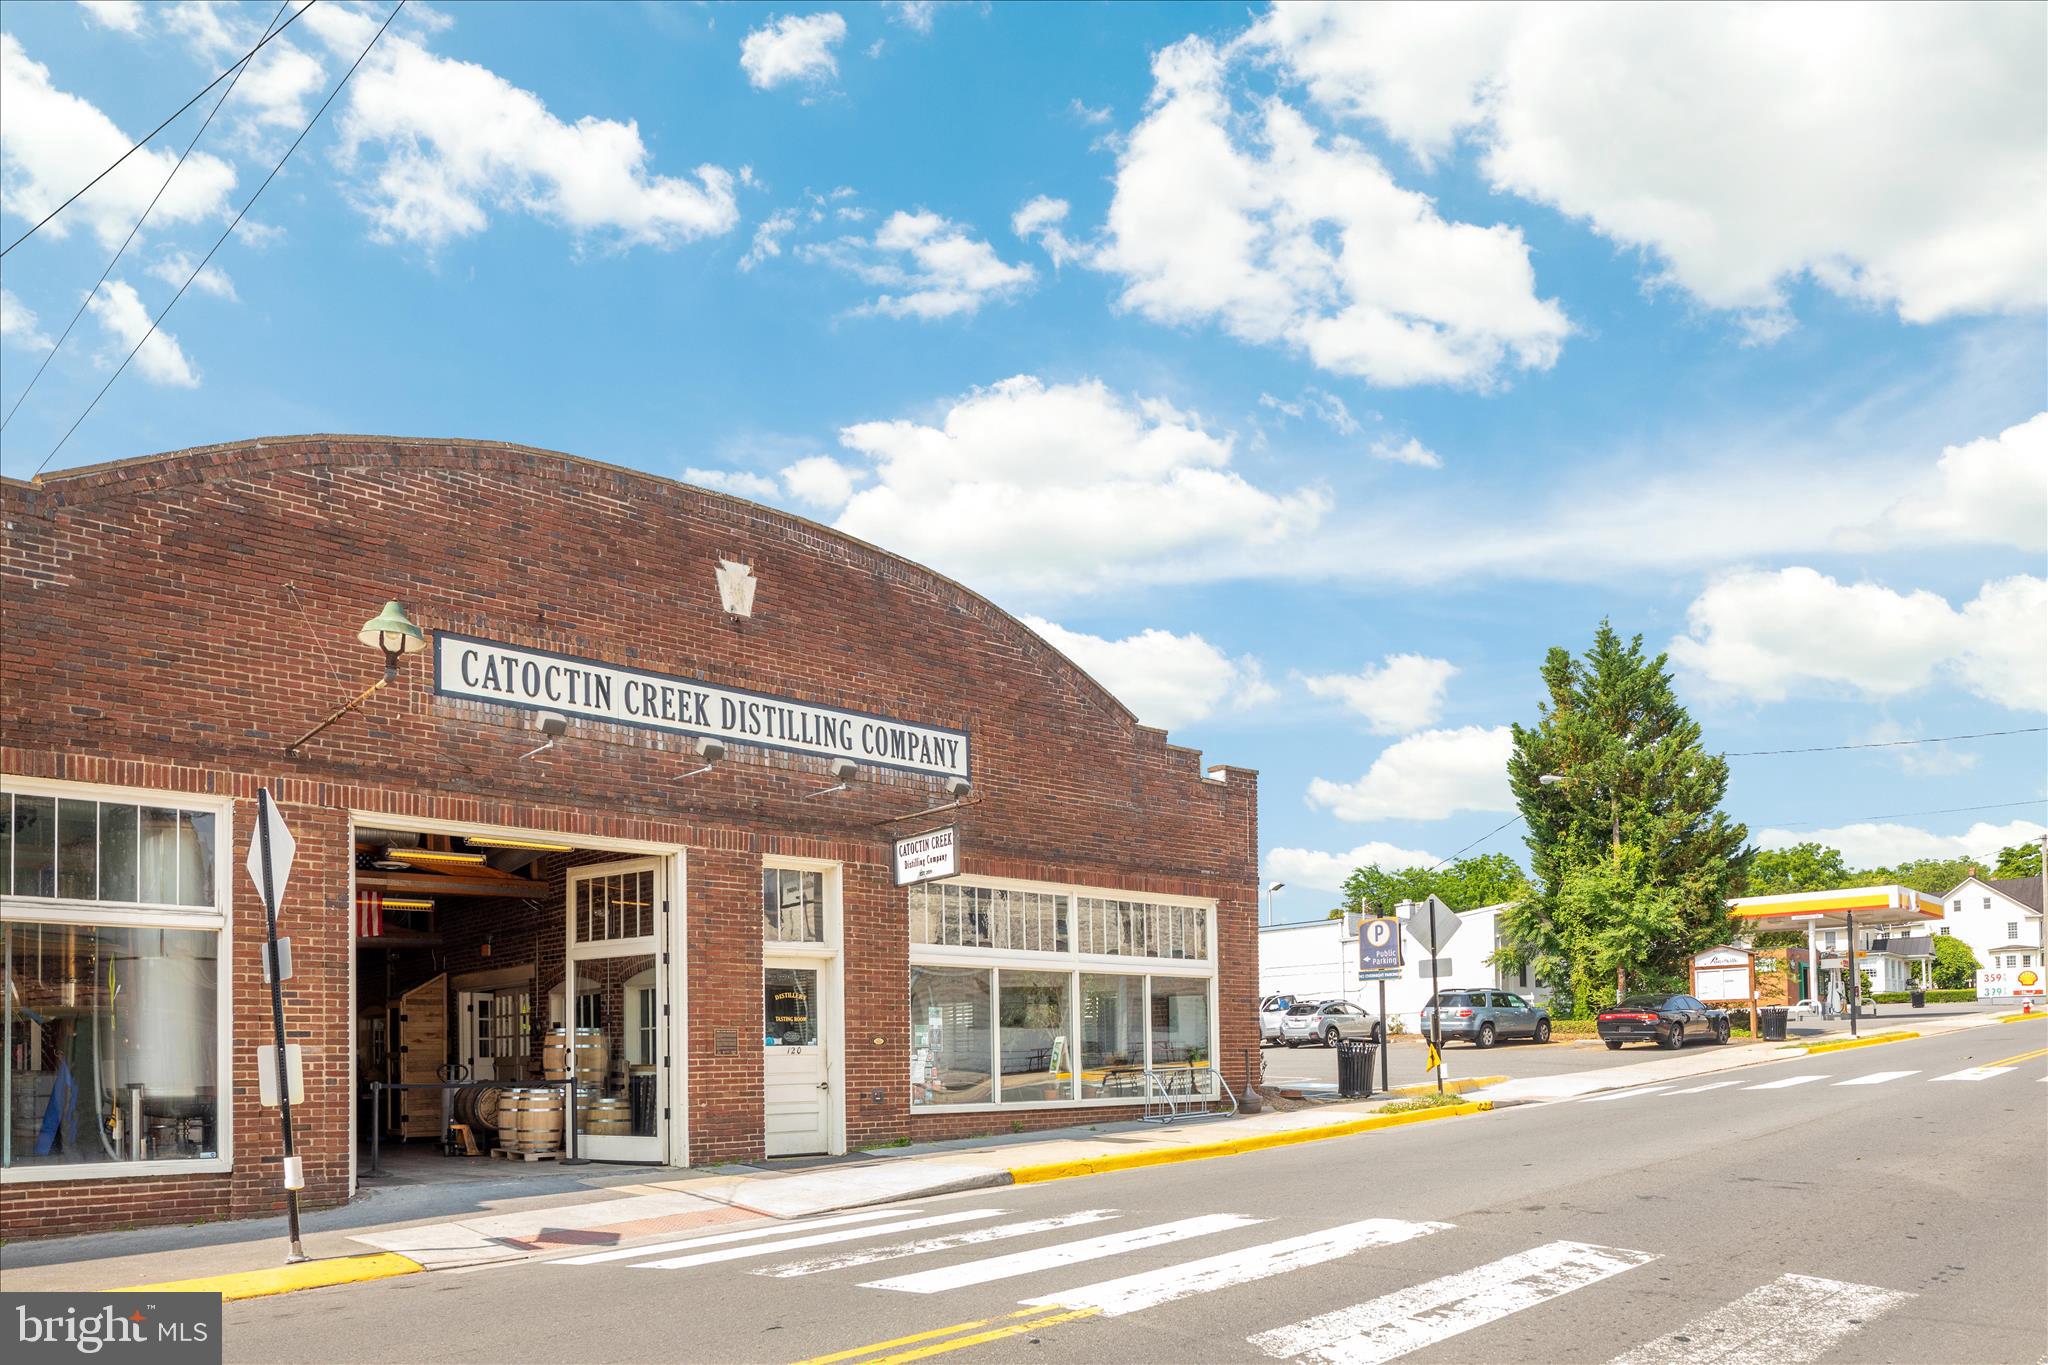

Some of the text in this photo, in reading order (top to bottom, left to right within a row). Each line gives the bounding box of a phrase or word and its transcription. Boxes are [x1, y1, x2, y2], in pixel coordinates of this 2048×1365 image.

[461, 649, 959, 769] CATOCTIN CREEK DISTILLING COMPANY
[899, 832, 952, 857] CATOCTIN CREEK
[904, 854, 947, 869] Distilling Company
[1375, 925, 1383, 942] P
[1376, 949, 1396, 957] Public
[1372, 956, 1397, 965] Parking
[1984, 973, 2002, 983] 359
[775, 991, 808, 1001] DISTILLERY
[787, 1046, 802, 1055] 120
